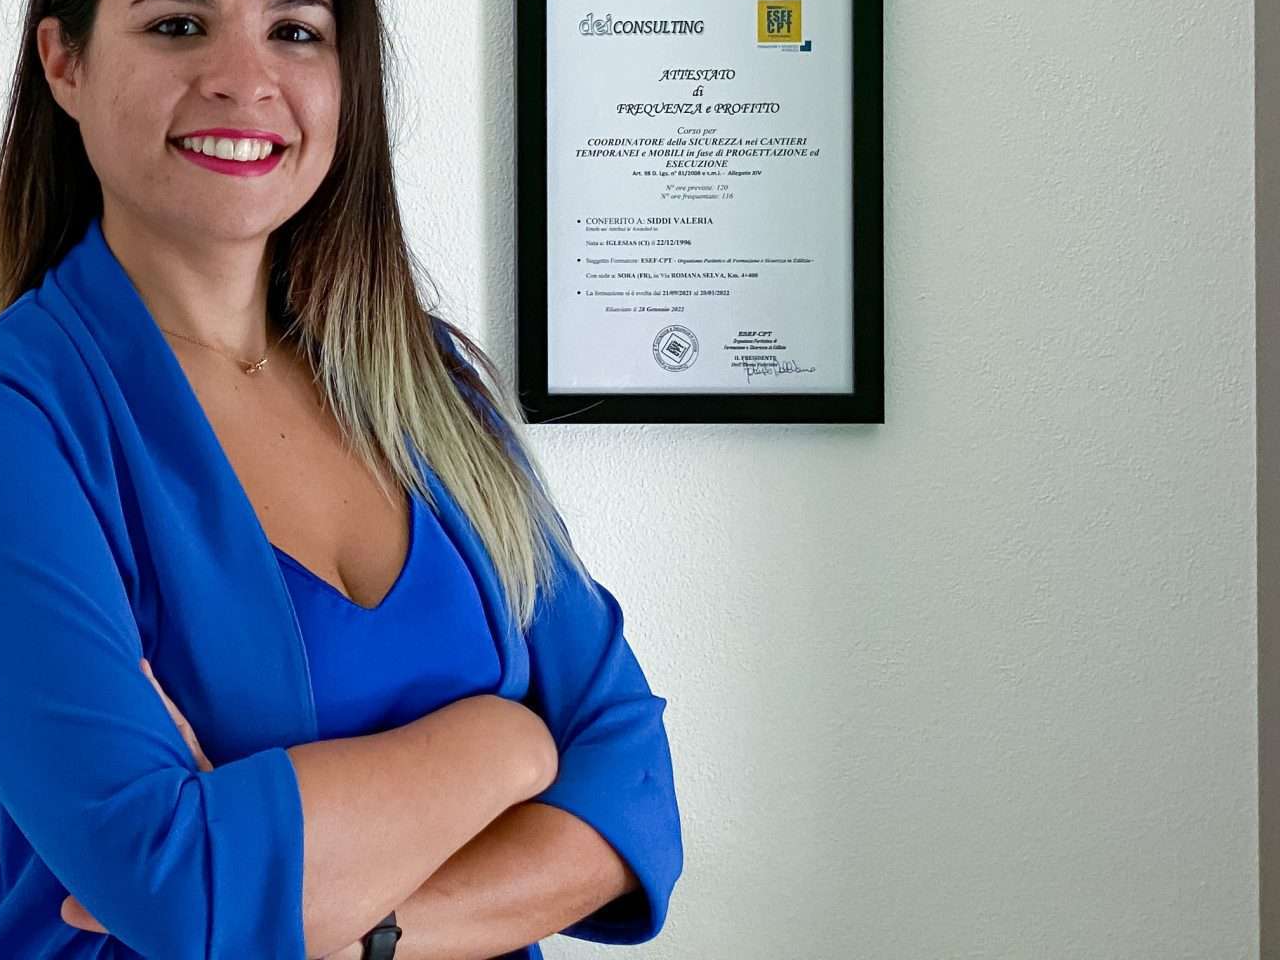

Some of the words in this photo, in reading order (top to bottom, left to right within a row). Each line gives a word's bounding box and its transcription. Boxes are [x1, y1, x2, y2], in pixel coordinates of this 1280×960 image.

[766, 21, 792, 34] CPT
[659, 69, 736, 82] ATTESTATO
[693, 85, 704, 97] di
[617, 102, 703, 118] FREQUENZA
[706, 106, 712, 114] e
[714, 103, 780, 116] PROFITTO
[677, 127, 702, 135] Corso
[588, 138, 665, 146] COORDINATORE
[667, 138, 687, 146] della
[688, 137, 743, 146] SICUREZZA
[745, 138, 758, 146] nei
[760, 138, 807, 146] CANTIERI
[649, 149, 685, 157] MOBILI
[686, 149, 695, 157] in
[695, 150, 714, 159] fase
[716, 149, 724, 157] di
[726, 149, 808, 157] PROGETTAZIONE
[666, 160, 729, 168] ESECUZIONE
[674, 217, 713, 225] VALERIA
